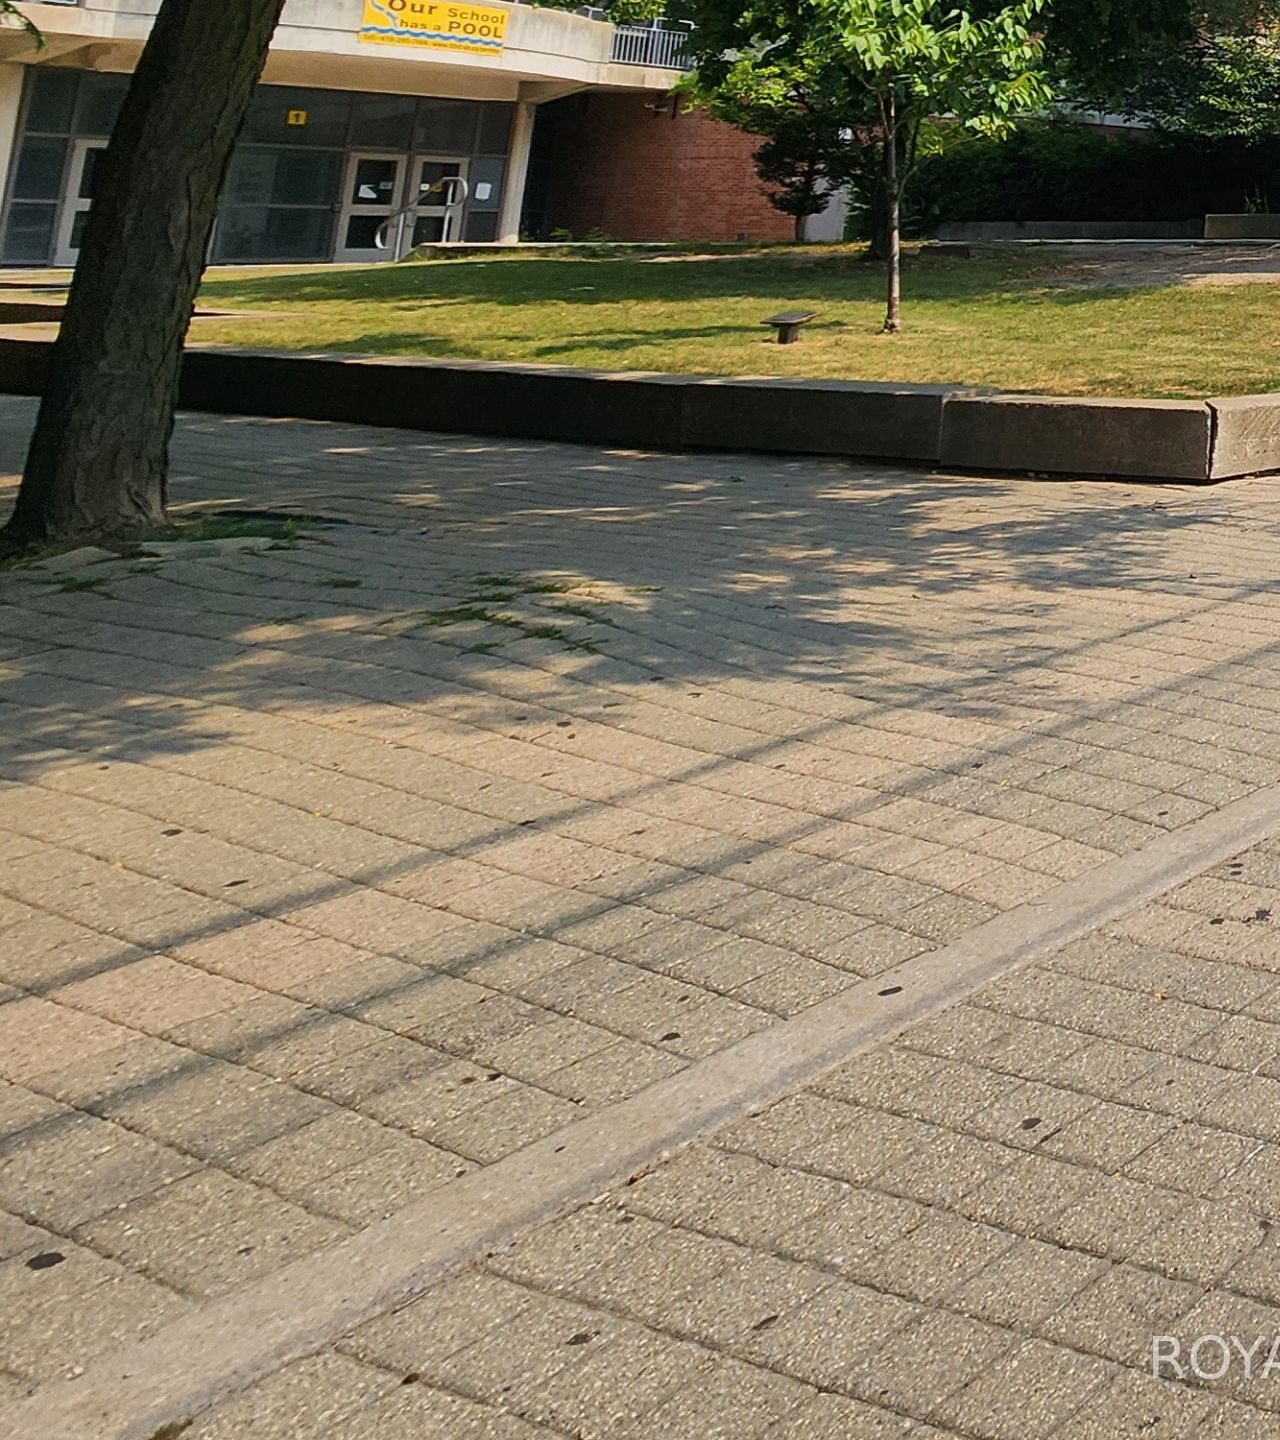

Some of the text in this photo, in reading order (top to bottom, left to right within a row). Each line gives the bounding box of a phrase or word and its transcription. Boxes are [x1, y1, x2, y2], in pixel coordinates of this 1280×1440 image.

[447, 7, 505, 24] School
[400, 18, 428, 30] has
[447, 20, 503, 39] POOL
